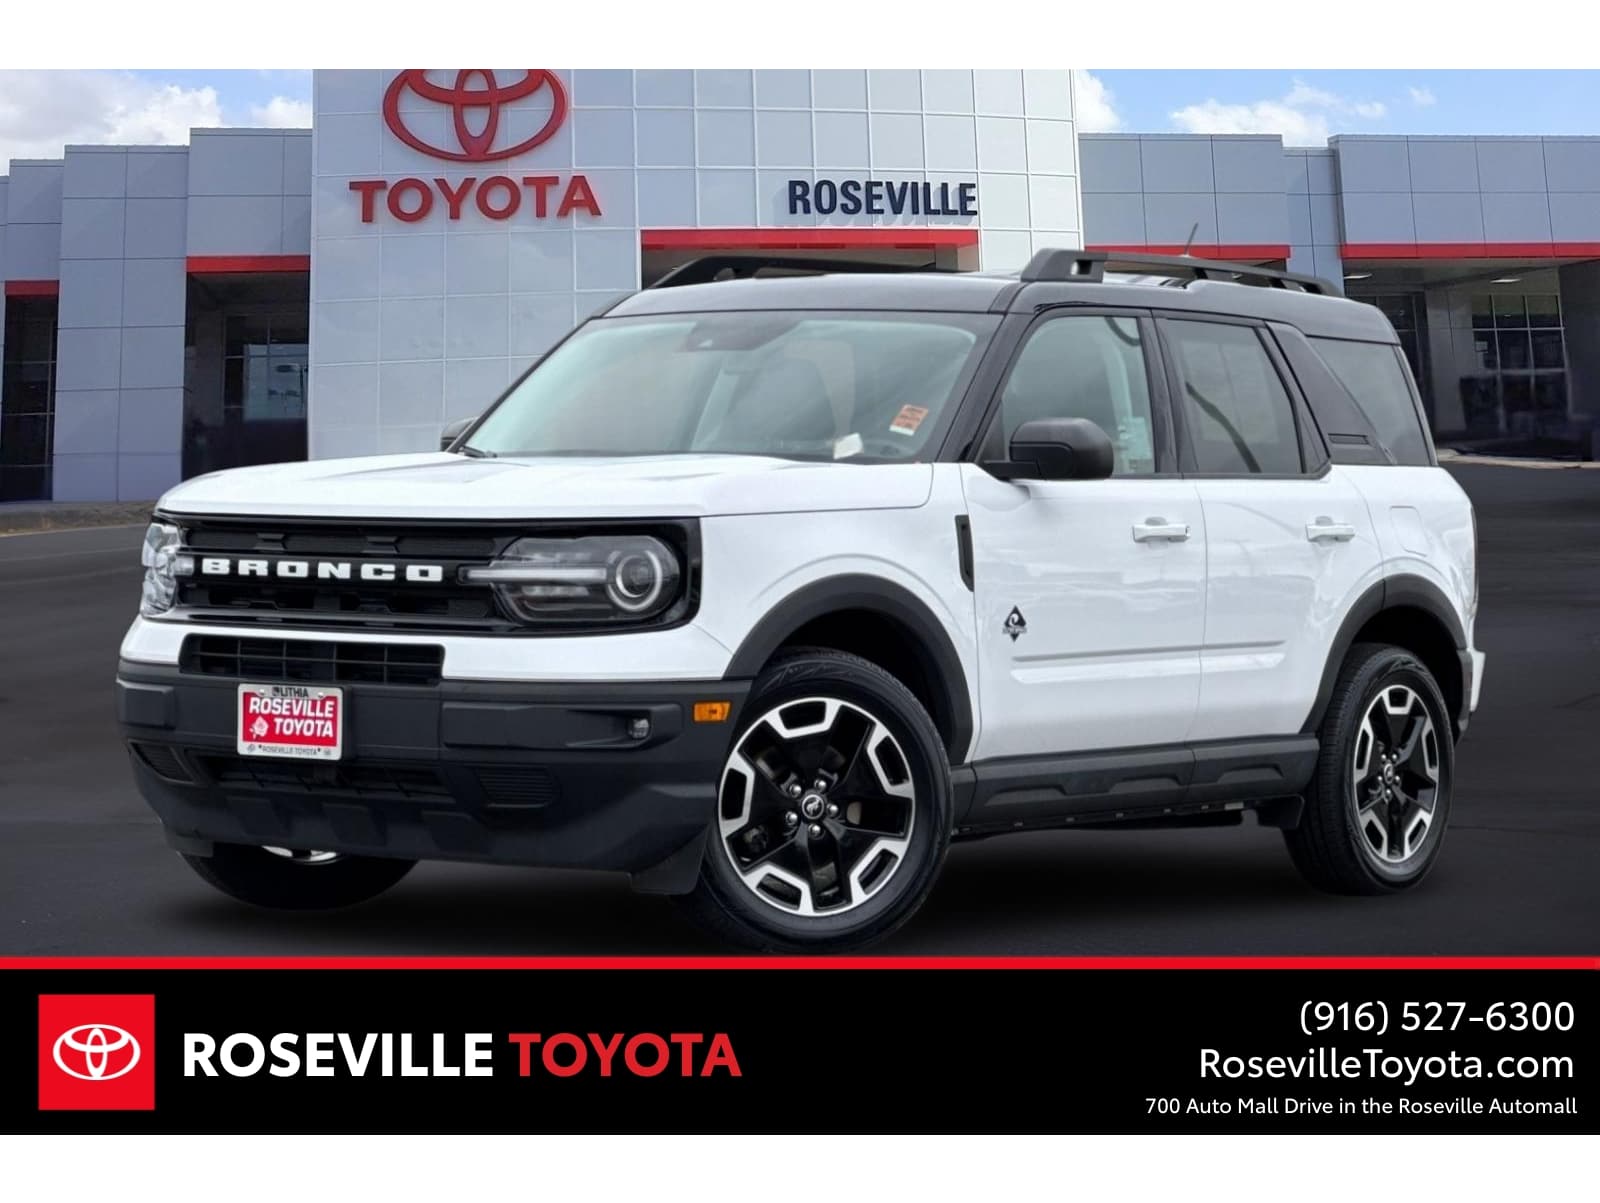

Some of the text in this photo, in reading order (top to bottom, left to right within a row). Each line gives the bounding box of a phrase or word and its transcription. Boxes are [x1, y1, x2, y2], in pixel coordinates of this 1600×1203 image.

[349, 175, 602, 223] TOYOTA
[788, 179, 978, 217] ROSEVILLE
[202, 558, 443, 582] BRONCO
[249, 697, 334, 717] ROSEVILLE
[274, 718, 334, 737] TOYOTA
